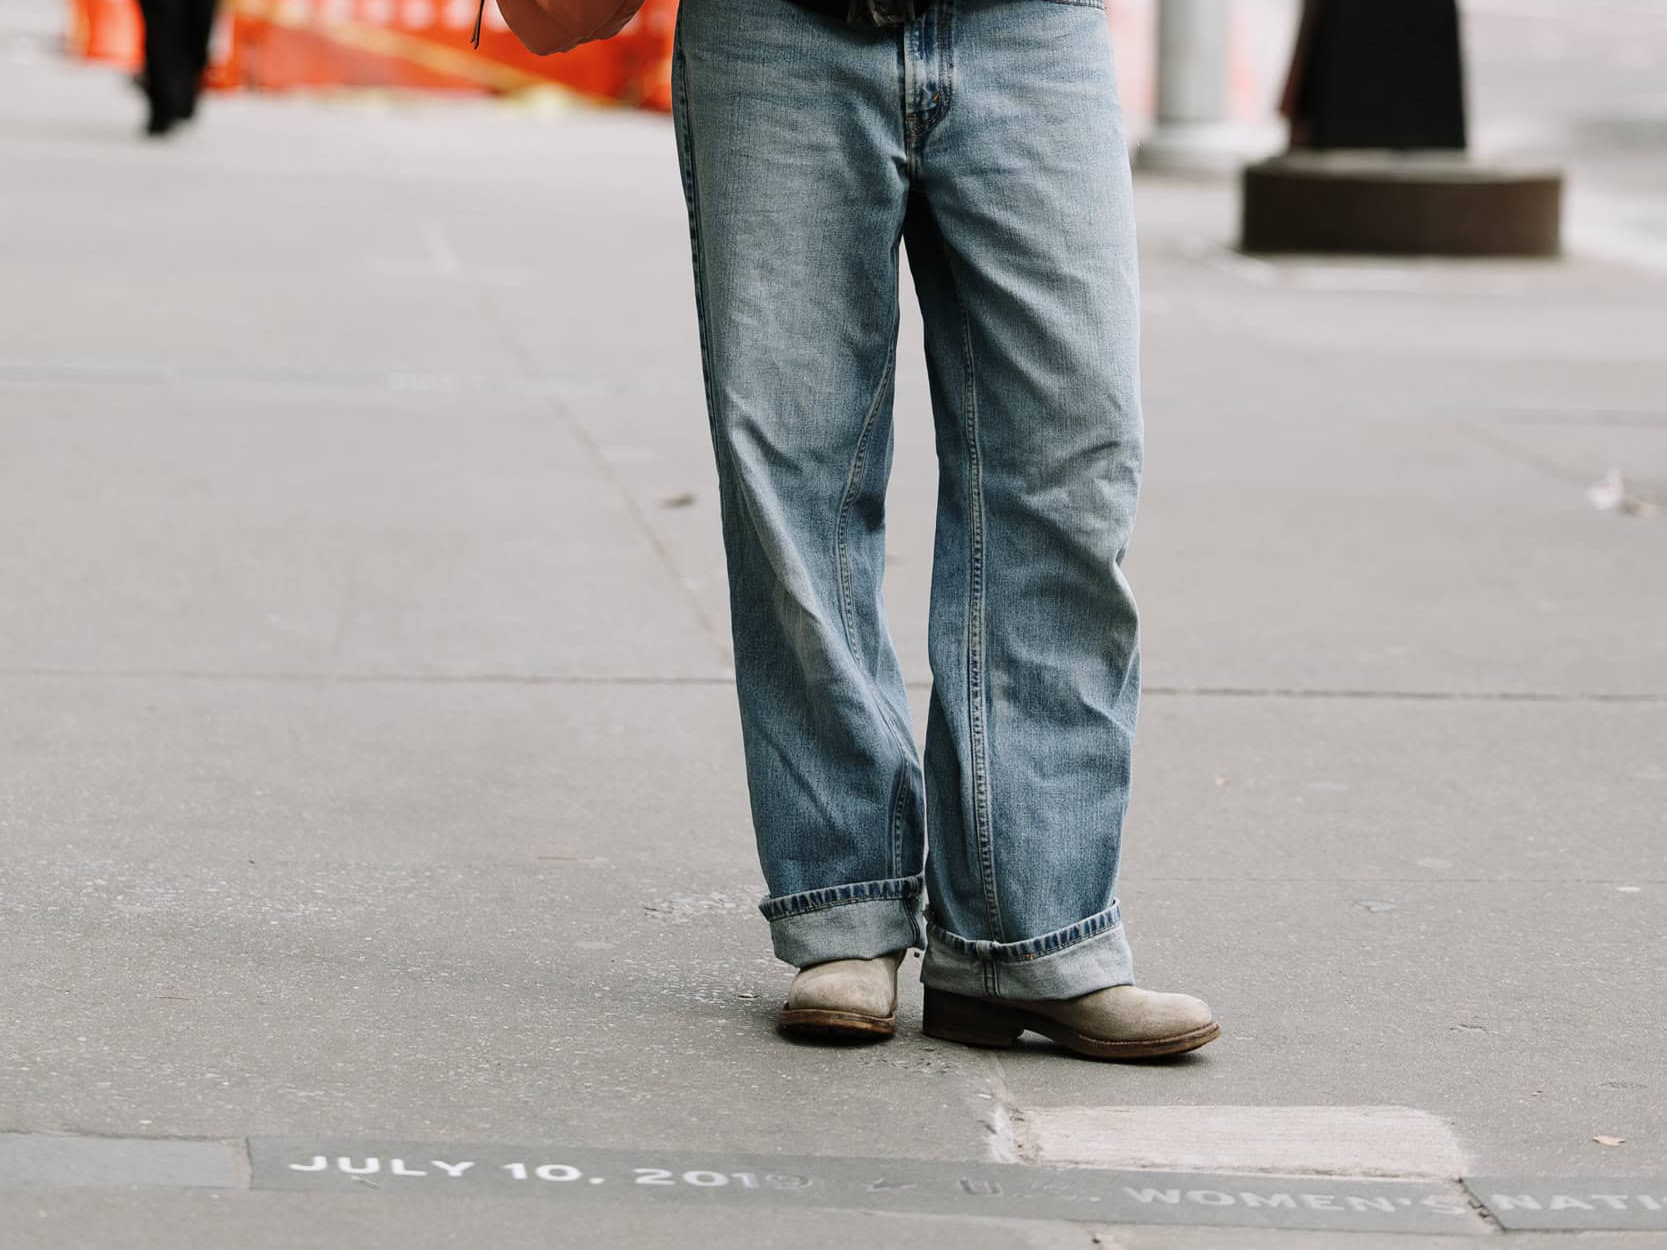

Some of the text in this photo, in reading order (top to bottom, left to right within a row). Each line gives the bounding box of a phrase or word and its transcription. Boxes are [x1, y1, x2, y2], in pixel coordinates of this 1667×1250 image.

[287, 1155, 476, 1177] JULY
[1122, 1187, 1467, 1216] WOMEN'S
[1490, 1193, 1667, 1211] NATI
